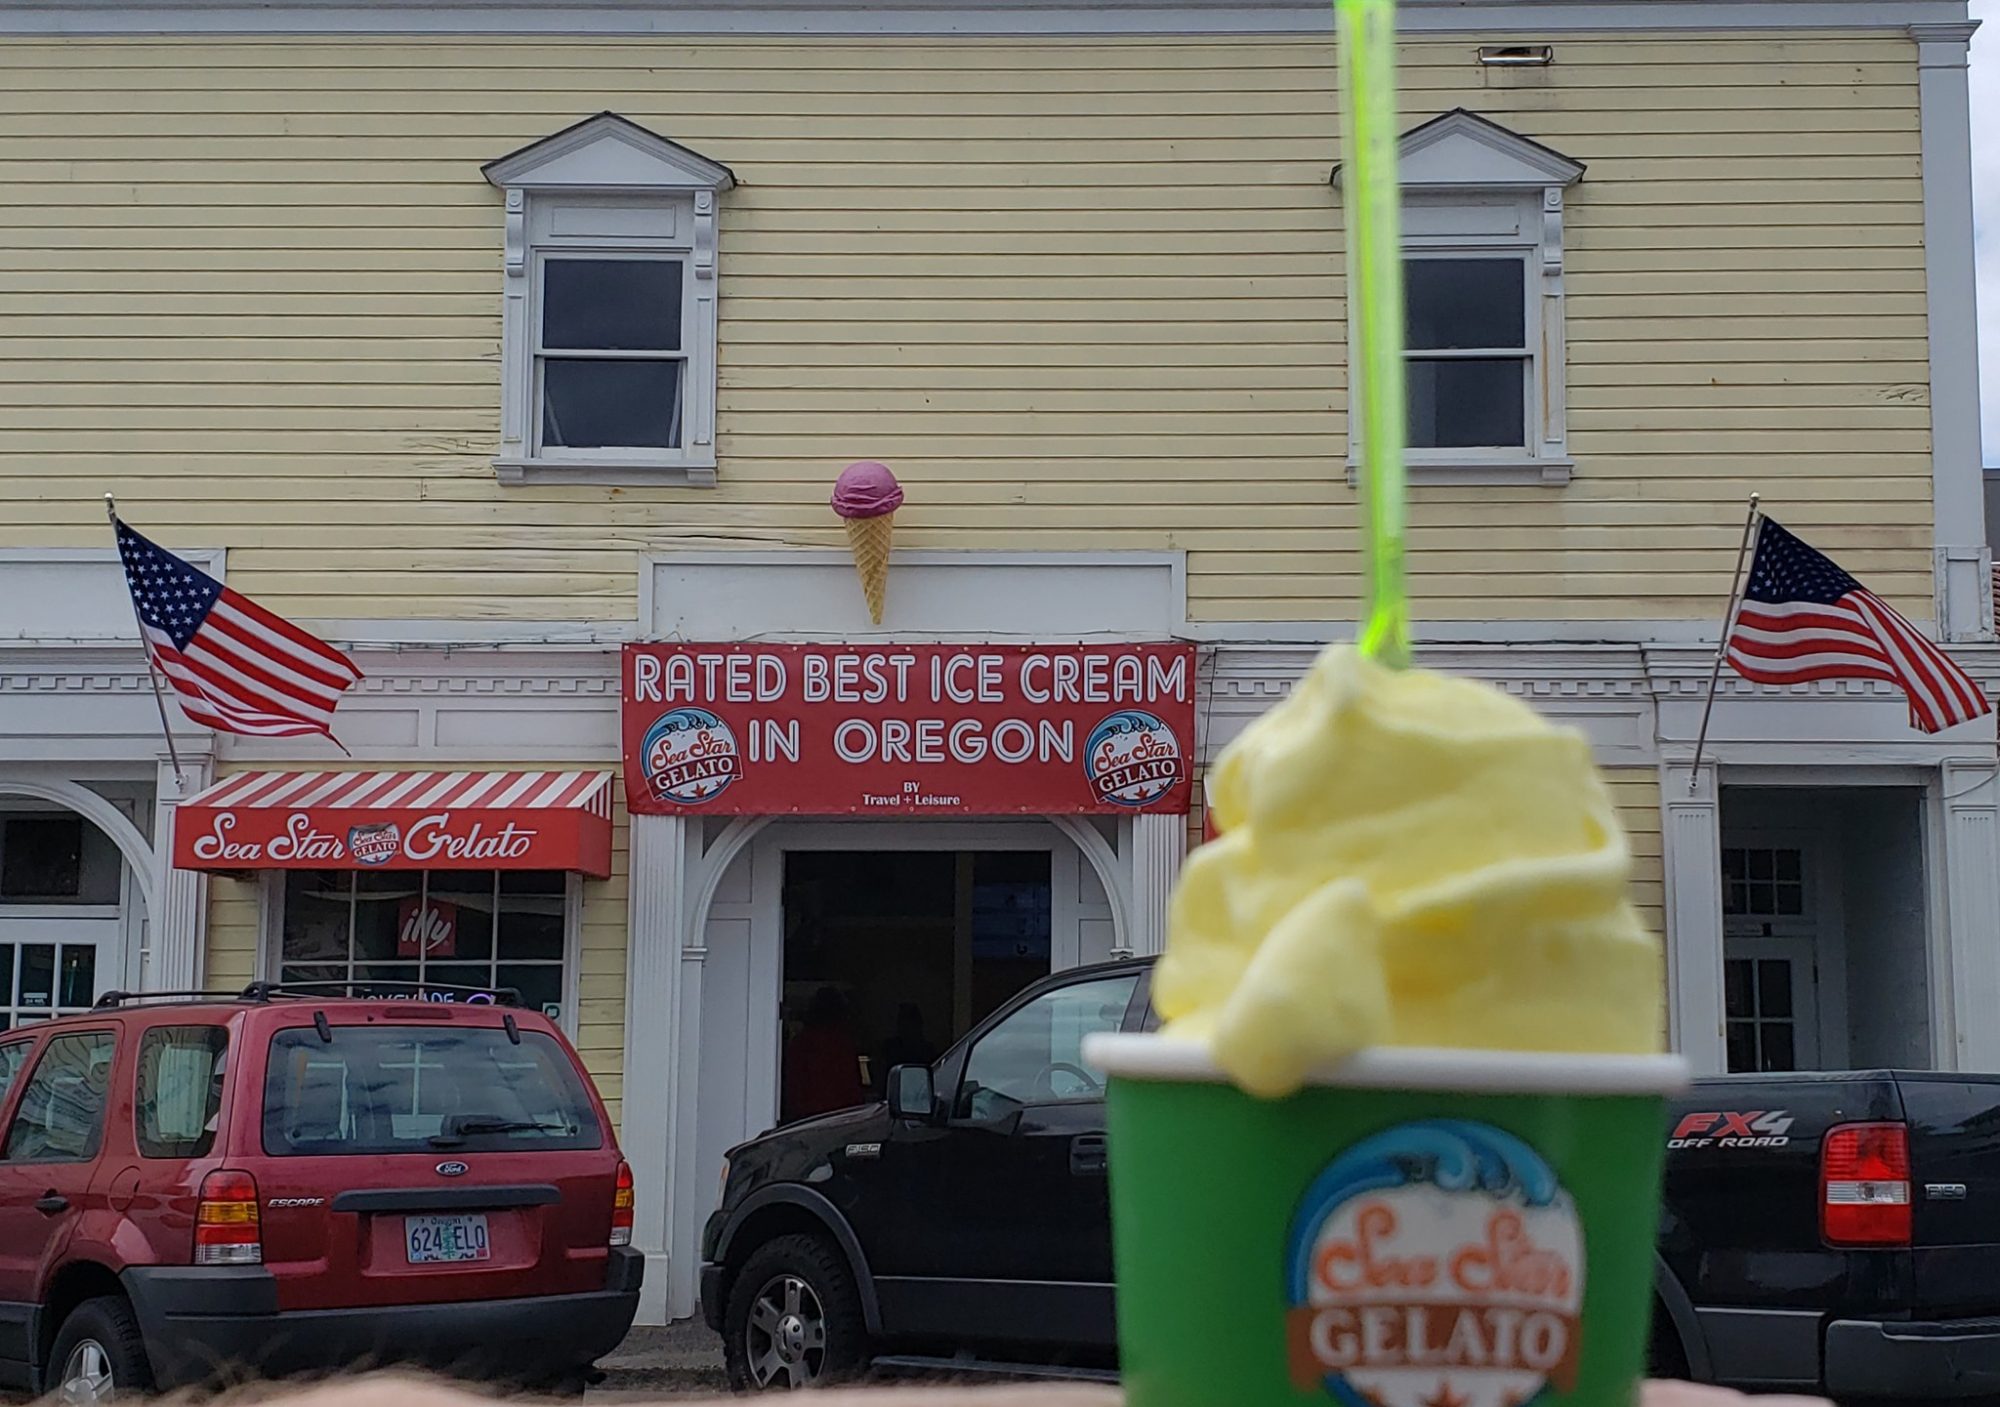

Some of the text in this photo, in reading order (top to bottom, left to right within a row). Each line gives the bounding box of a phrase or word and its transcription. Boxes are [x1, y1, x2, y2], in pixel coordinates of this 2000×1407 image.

[635, 654, 1186, 703] RATED BEST ICE CREAM
[652, 731, 731, 770] Sea Star
[749, 719, 1073, 763] IN OREGON
[1095, 733, 1174, 772] Sea Star
[656, 758, 733, 789] GELATO
[903, 782, 920, 793] BY
[1099, 760, 1176, 792] GELATO
[863, 794, 900, 806] Travel
[915, 794, 960, 806] Leisure
[193, 812, 537, 860] Sea Star Gelato
[353, 842, 397, 858] GELATO
[401, 908, 451, 950] illy
[1672, 1110, 1794, 1138] FX4
[1667, 1136, 1789, 1149] OFF ROAD
[268, 1198, 325, 1207] ESCAPE
[411, 1227, 442, 1252] 624
[1309, 1306, 1570, 1368] GELATO
